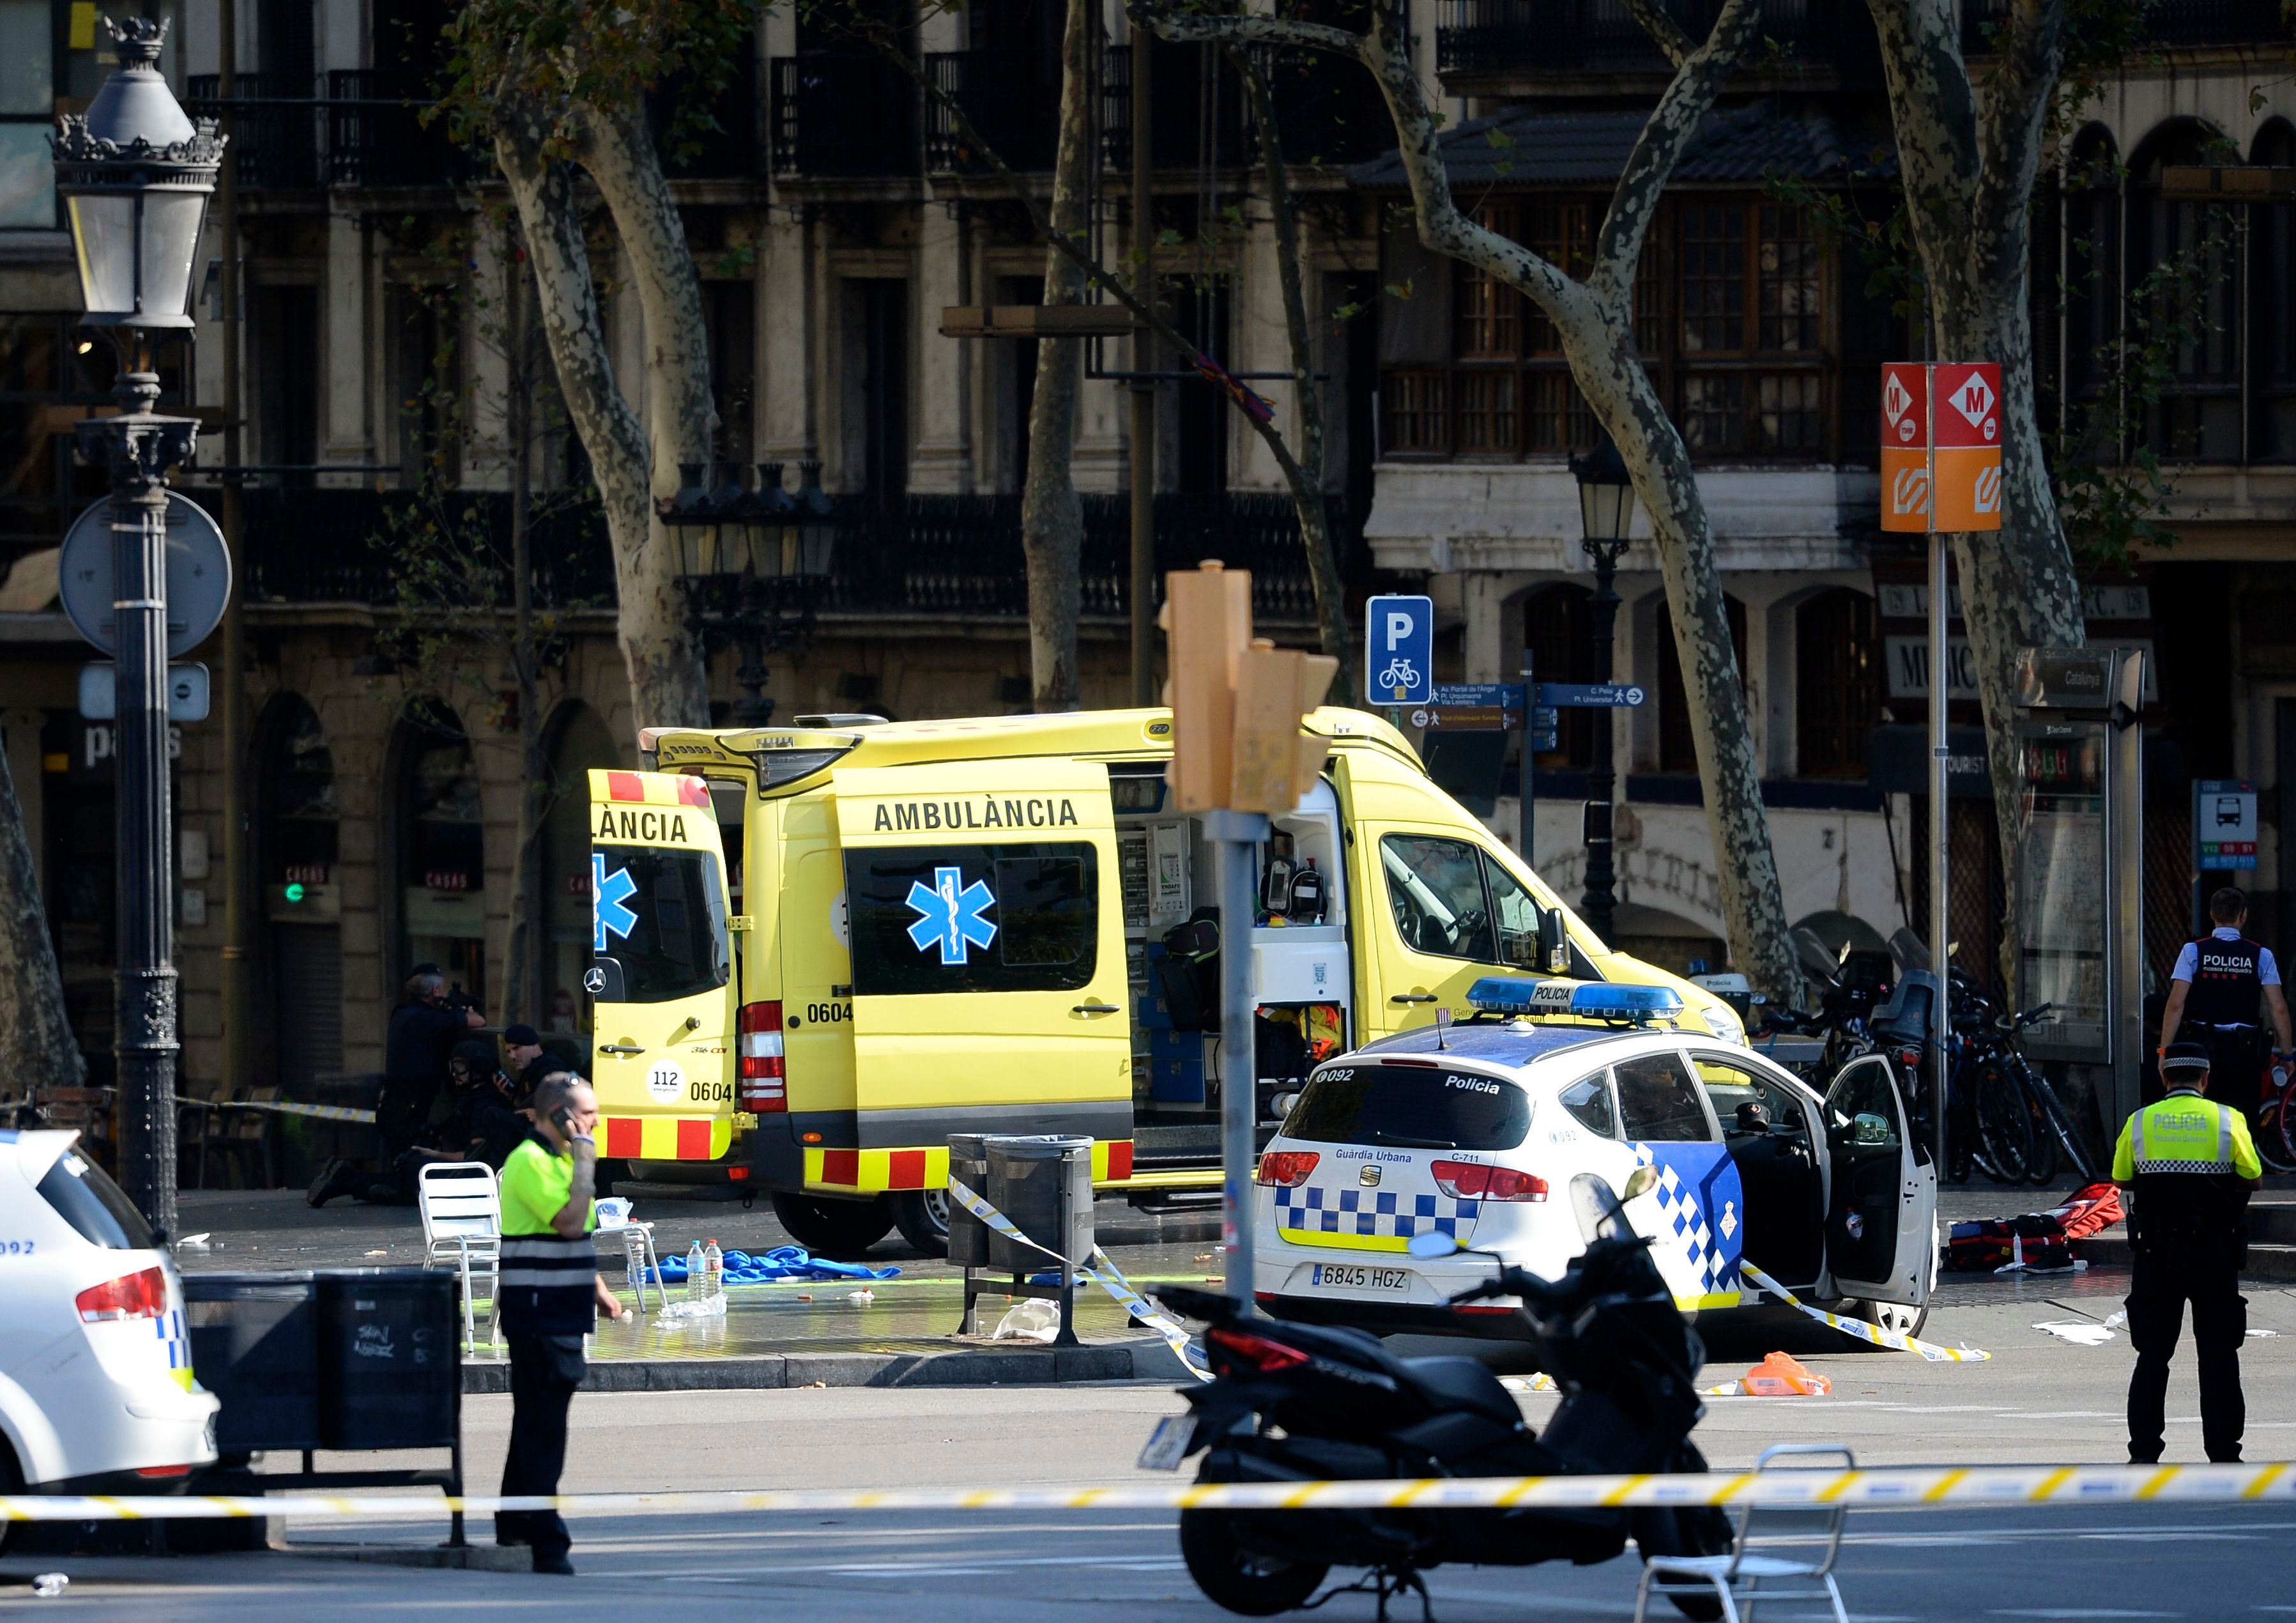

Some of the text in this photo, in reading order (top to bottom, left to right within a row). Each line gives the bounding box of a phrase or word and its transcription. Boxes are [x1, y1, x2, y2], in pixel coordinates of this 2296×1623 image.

[1888, 387, 1899, 413] M
[1966, 387, 1984, 413] M
[1388, 613, 1414, 651] P
[2065, 671, 2100, 689] Catalunya
[1947, 755, 1986, 774] OURIST
[875, 794, 1078, 831] AMBULÀNCIA
[2203, 955, 2253, 968] POLICIA
[1534, 987, 1570, 1000] POLICIA
[807, 1003, 853, 1023] 0604
[654, 1071, 678, 1086] 112
[1327, 1069, 1354, 1082] 092
[691, 1082, 733, 1102] 0604
[1445, 1075, 1501, 1095] Policia
[2154, 1114, 2207, 1131] POLICIA
[1559, 1130, 1577, 1142] 092
[1336, 1149, 1412, 1163] Guàrdia Urbana
[1451, 1153, 1480, 1163] C-711
[1324, 1266, 1365, 1286] 6845
[1371, 1269, 1406, 1288] HGZ
